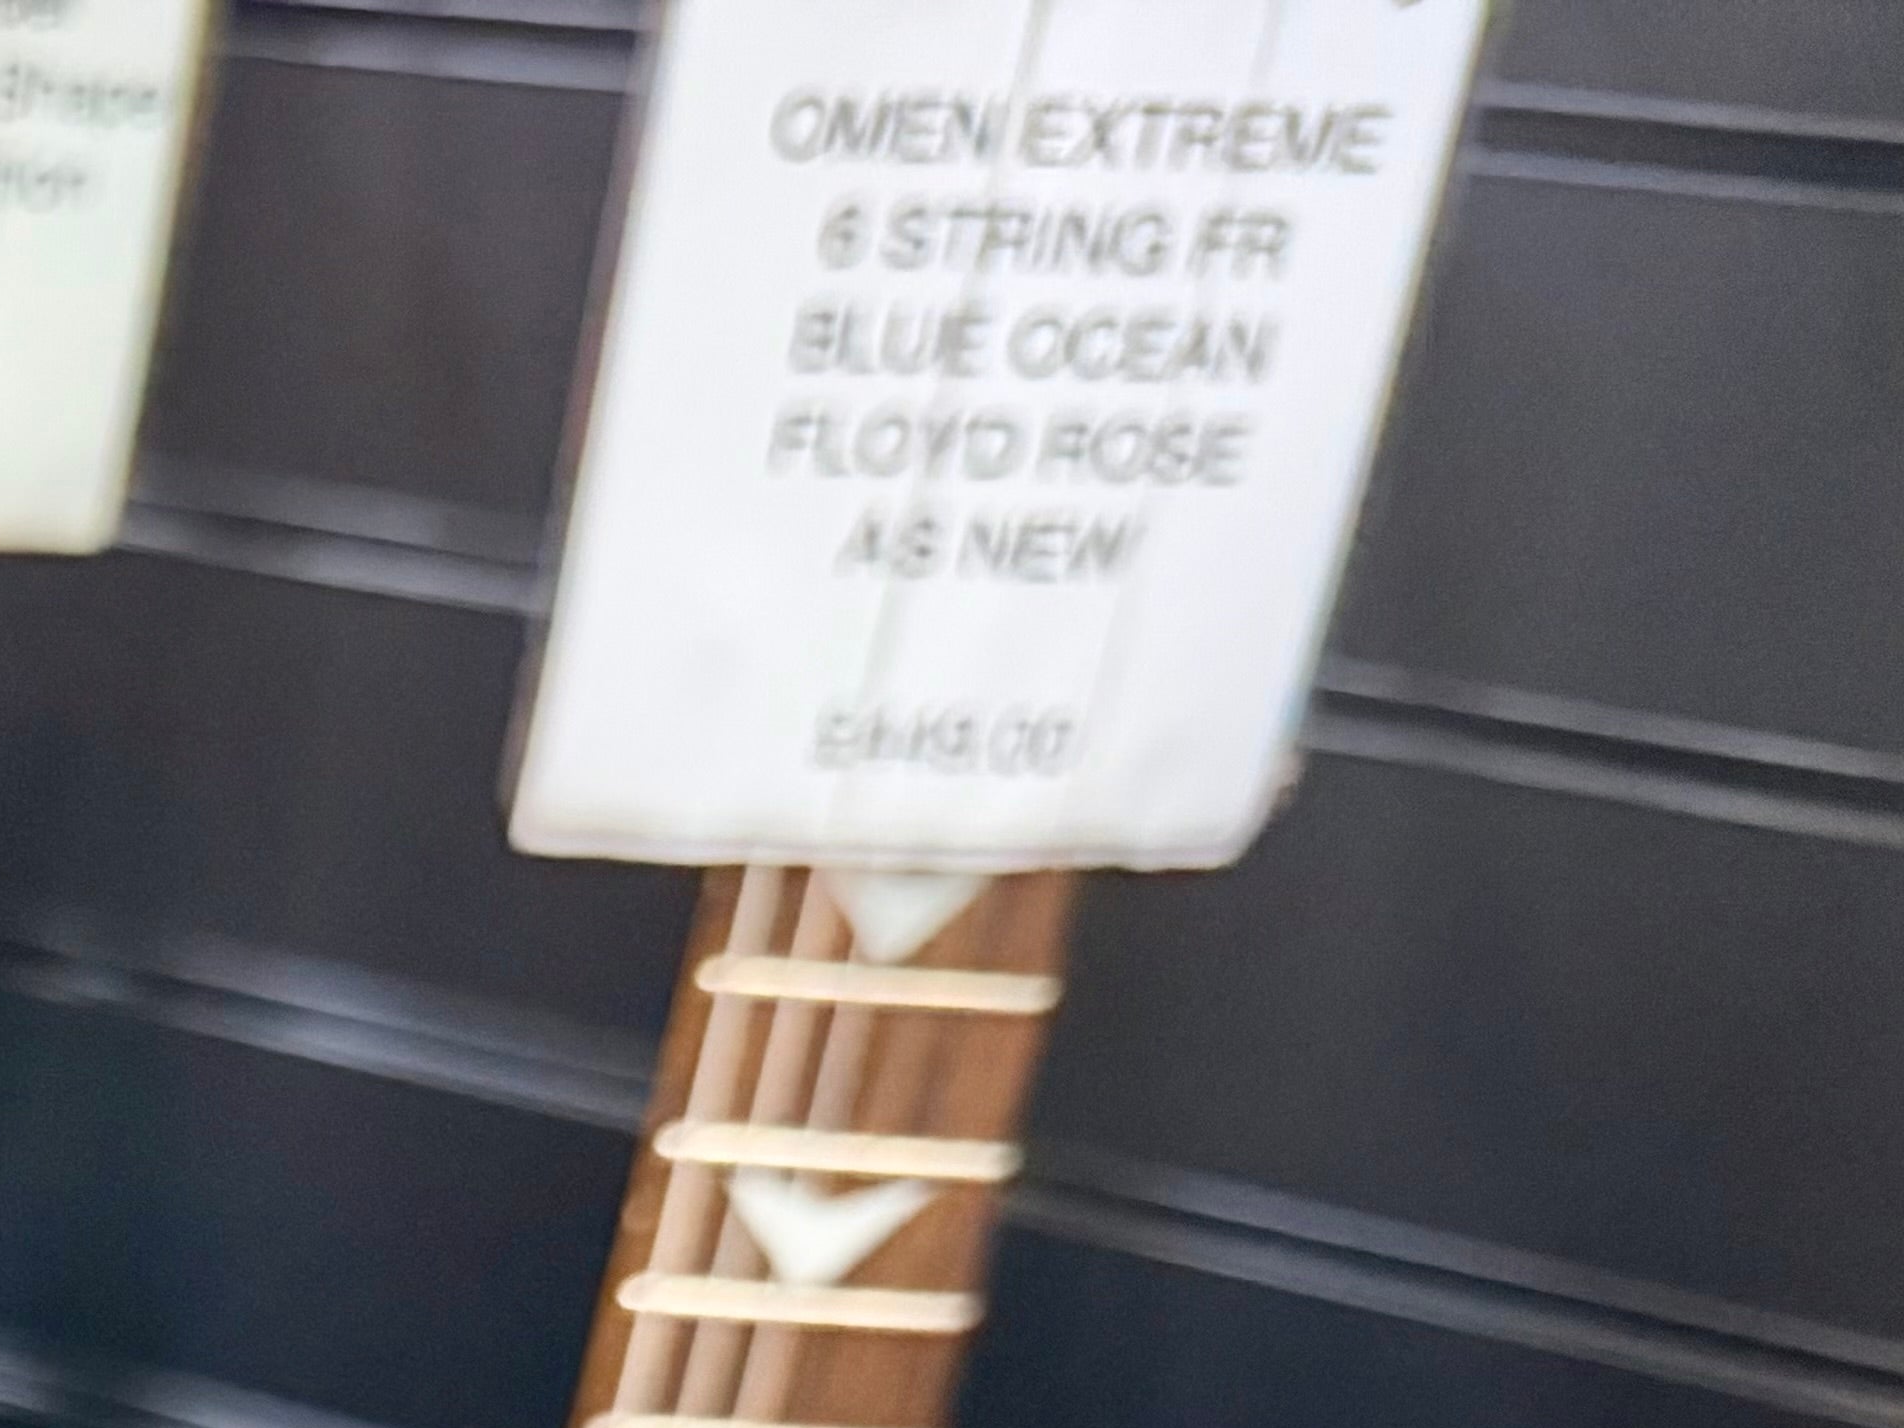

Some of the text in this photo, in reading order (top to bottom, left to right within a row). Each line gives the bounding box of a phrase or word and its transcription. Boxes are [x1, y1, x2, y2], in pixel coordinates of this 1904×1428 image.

[770, 87, 1392, 174] OMEN EXTREME
[817, 203, 1295, 280] 6 STRING FR
[788, 306, 1278, 383] BLUE OCEAN
[768, 412, 1252, 486] FLOYD ROSE
[834, 508, 1136, 583] AS NEW
